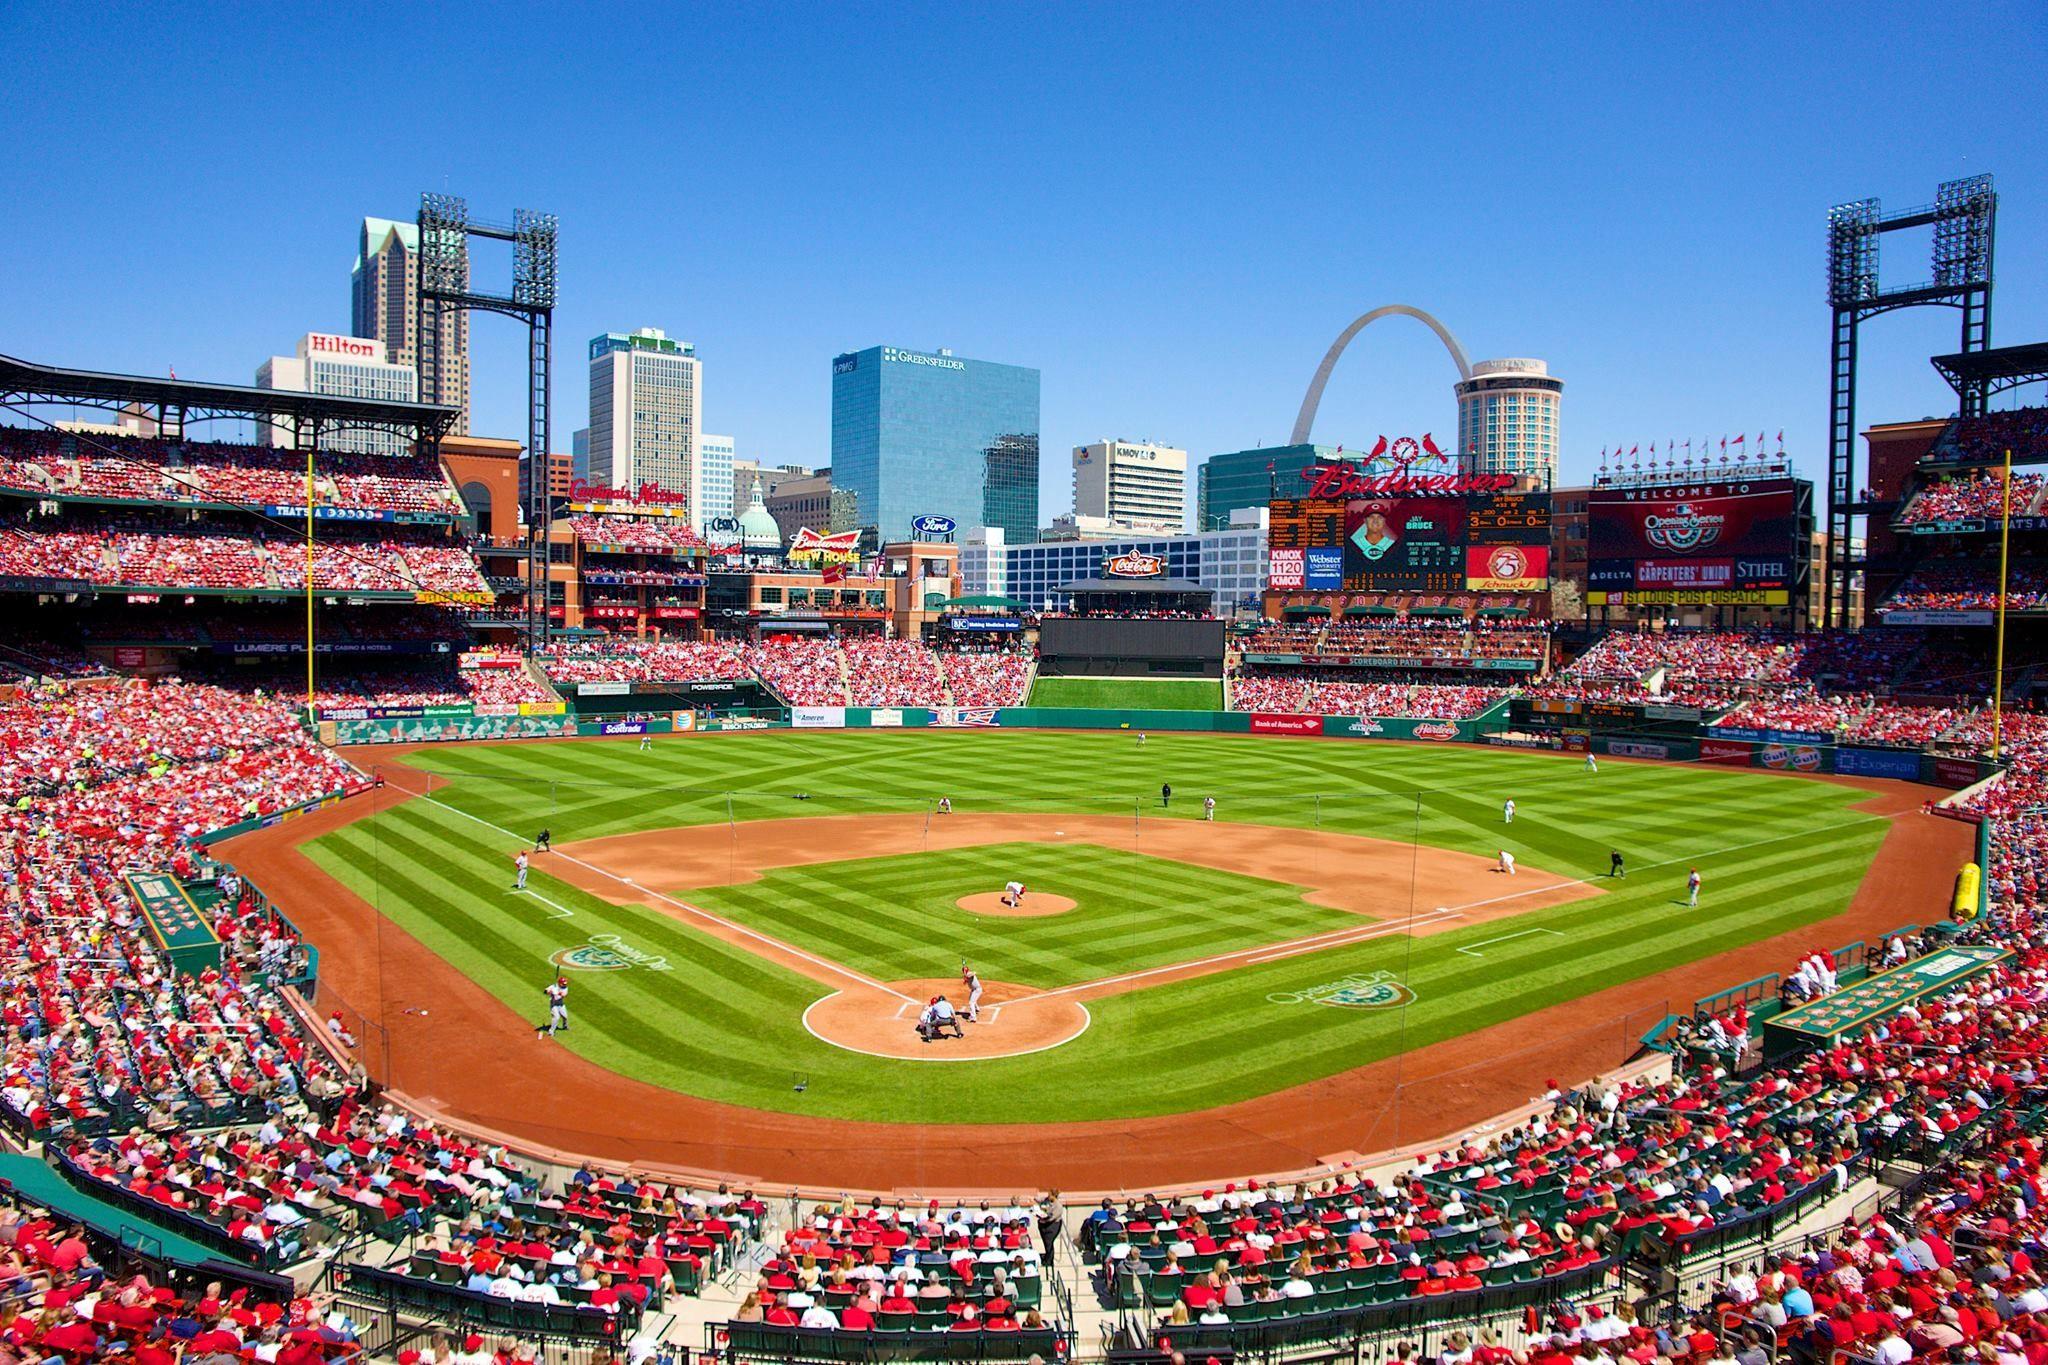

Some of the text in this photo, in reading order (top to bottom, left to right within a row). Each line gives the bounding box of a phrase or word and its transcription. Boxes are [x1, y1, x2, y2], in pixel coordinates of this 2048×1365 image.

[312, 335, 374, 356] Hilton
[833, 361, 853, 375] KPMG
[1116, 448, 1140, 458] KMOV
[1301, 463, 1517, 498] Budweiser
[1610, 465, 1772, 485] WORLD CHAMPIONS
[569, 478, 686, 505] Cardinals Nation
[1625, 484, 1750, 500] WELCOME TO
[276, 506, 322, 517] THAT'S A
[717, 518, 733, 531] FOX
[922, 518, 948, 531] Ford
[1405, 522, 1434, 530] BRUCE
[1470, 517, 1480, 527] 3
[1645, 513, 1725, 530] Opening Series
[707, 534, 744, 545] MIDWEST
[789, 530, 860, 549] Budweiser
[789, 549, 861, 563] BREW HOUSE
[1271, 550, 1302, 560] KMOX
[1308, 554, 1342, 563] Webster
[1115, 558, 1155, 572] Coca-Cola
[1272, 562, 1302, 574] 1120
[1737, 561, 1787, 578] STIFEL
[1600, 572, 1632, 580] DELTA
[1639, 565, 1731, 582] CARPENTERS' UNION
[1271, 576, 1302, 586] KMOX
[1480, 580, 1534, 588] Schnucks
[1627, 590, 1767, 604] ST. LOUIS POST-DISPATCH
[953, 620, 967, 629] BJC
[1400, 659, 1422, 667] PATIO
[691, 683, 735, 691] POWERADE
[605, 723, 642, 734] Scottrade
[1278, 721, 1303, 729] America
[1762, 751, 1788, 761] Gulf
[1793, 753, 1819, 764] Gulf
[1860, 758, 1916, 773] Experian
